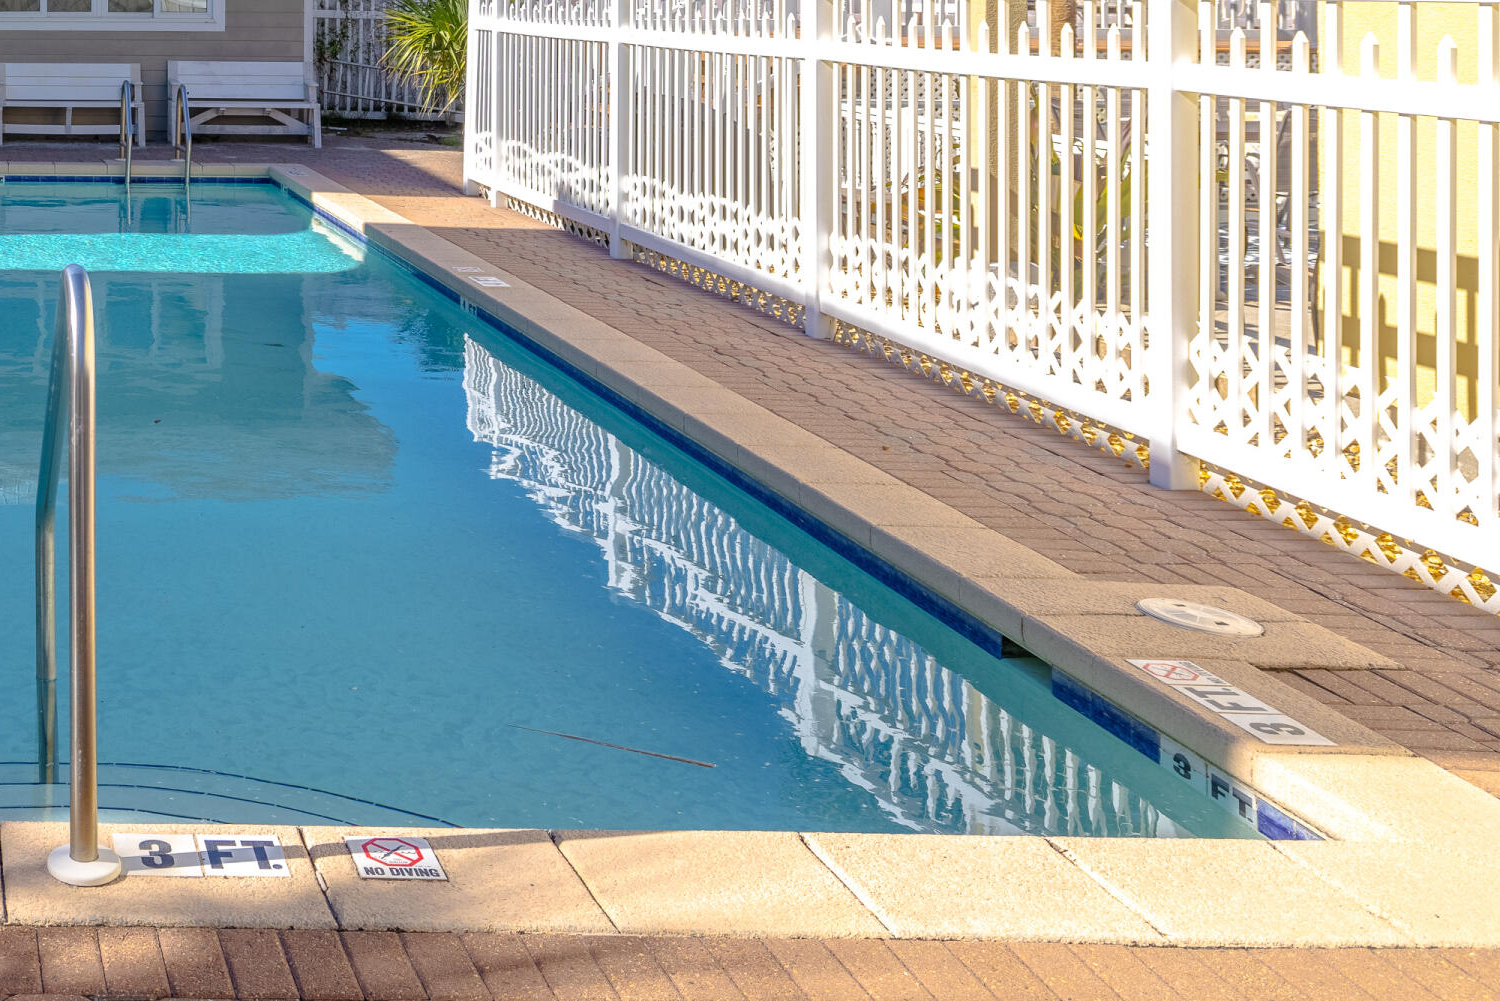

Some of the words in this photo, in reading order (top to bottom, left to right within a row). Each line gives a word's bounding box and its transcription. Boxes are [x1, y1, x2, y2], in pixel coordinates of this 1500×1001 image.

[1184, 686, 1268, 711] FT.
[1249, 722, 1306, 736] 3
[1172, 753, 1192, 780] 3
[138, 839, 175, 869] 3
[204, 839, 283, 870] FT.
[363, 866, 386, 876] NO
[389, 867, 440, 878] DIVING
